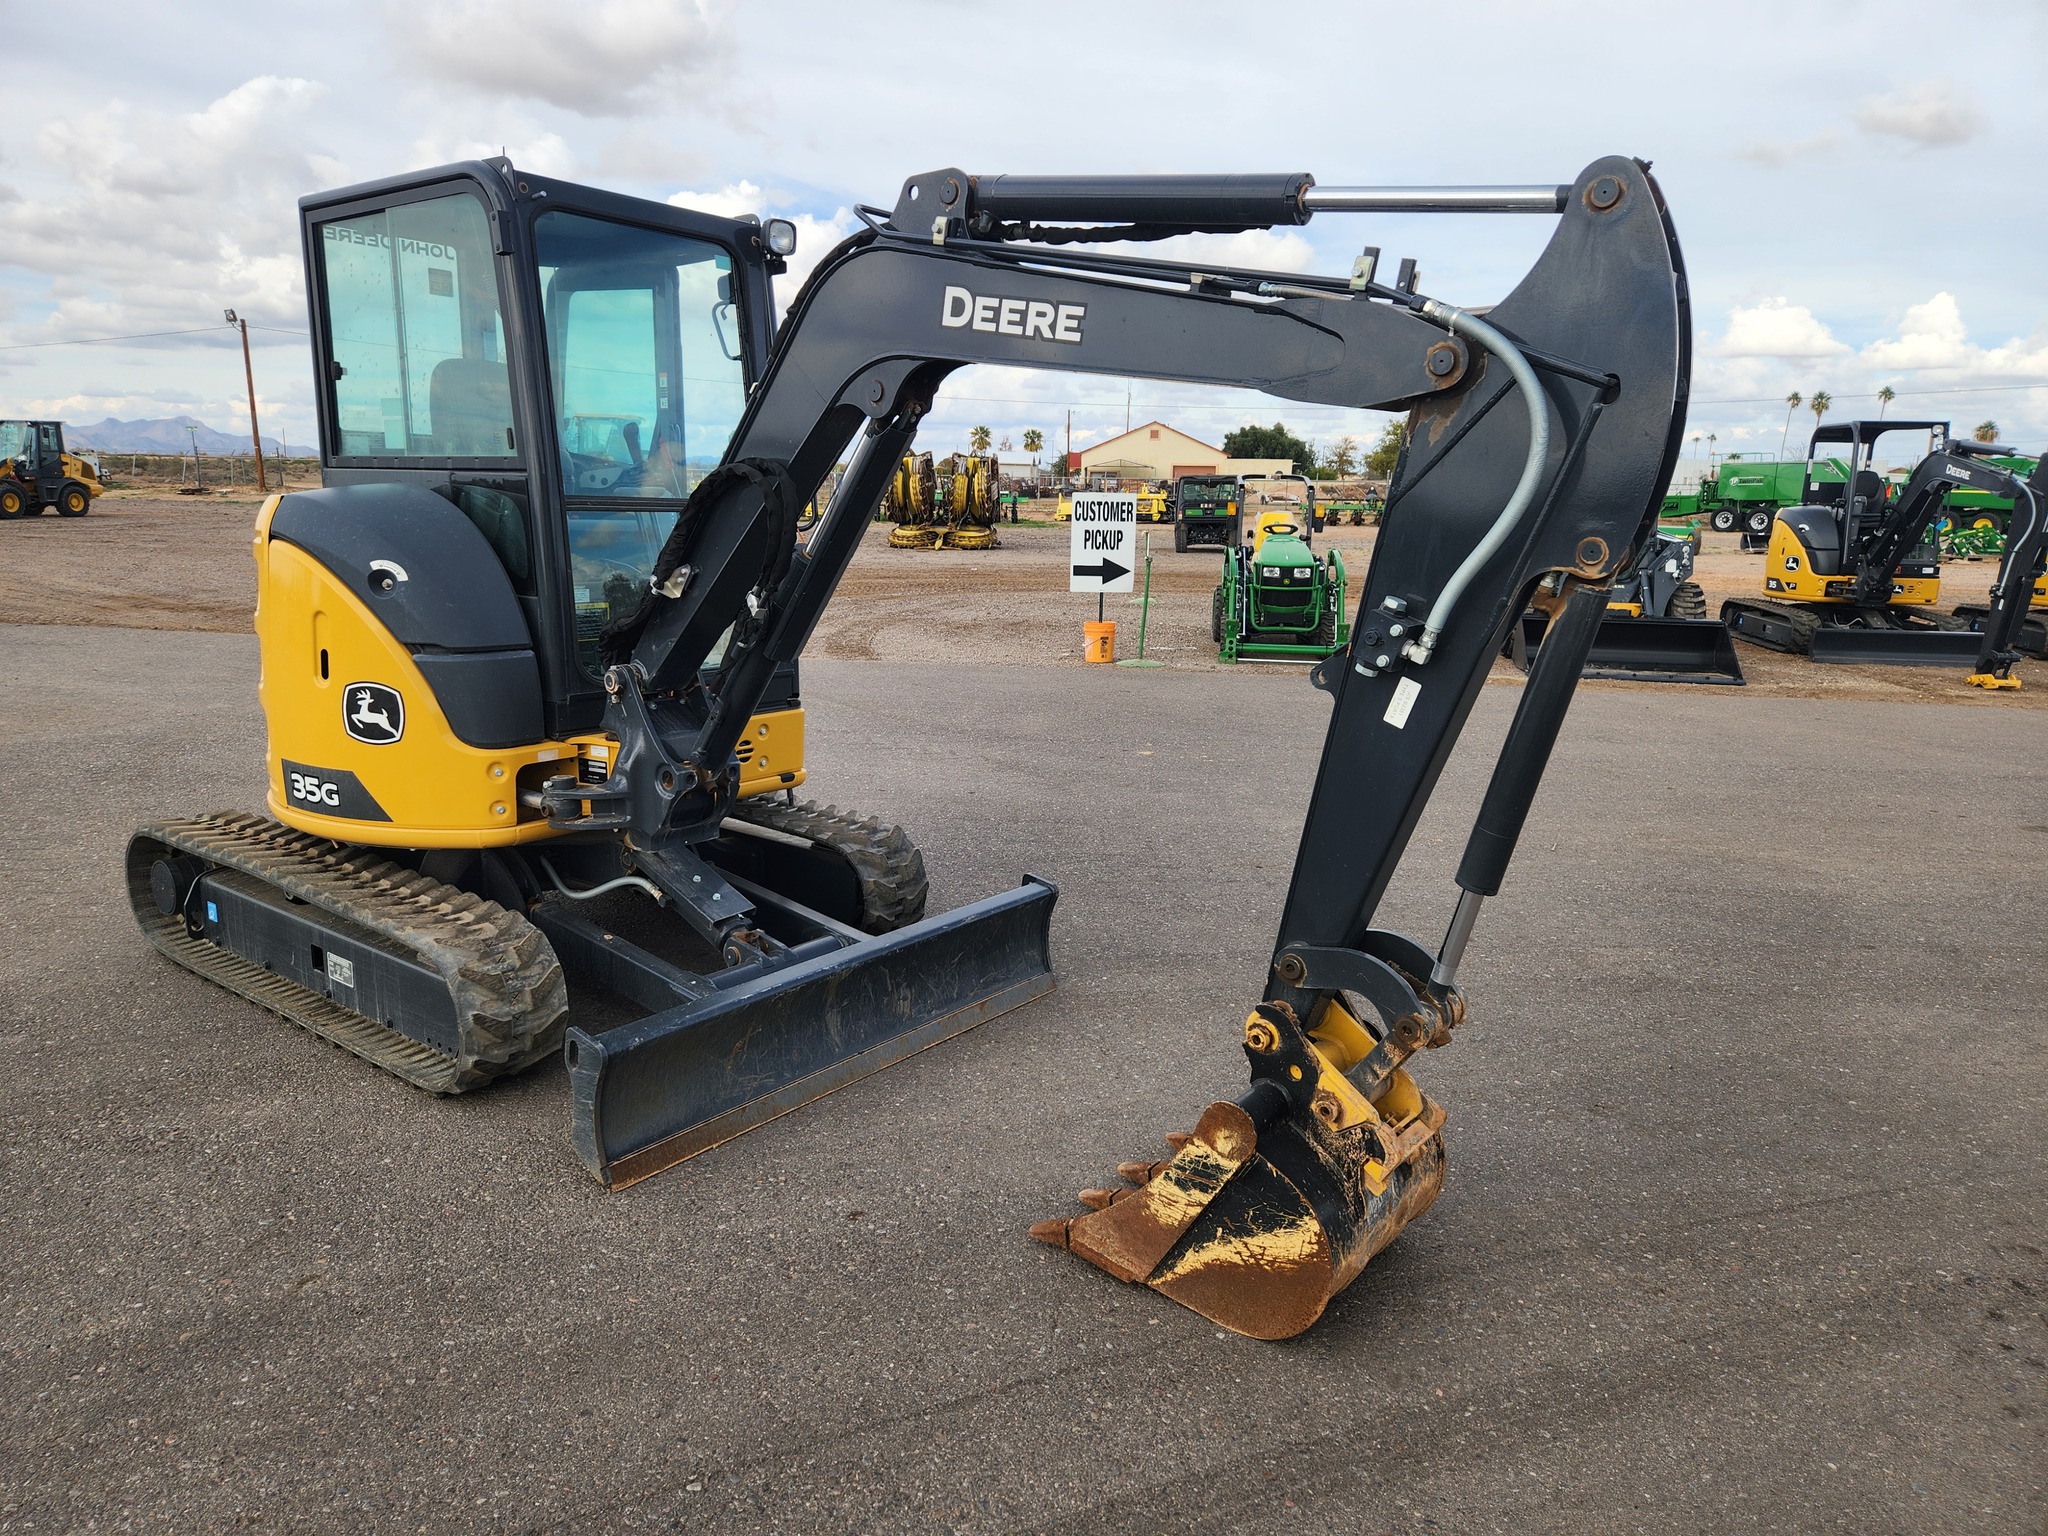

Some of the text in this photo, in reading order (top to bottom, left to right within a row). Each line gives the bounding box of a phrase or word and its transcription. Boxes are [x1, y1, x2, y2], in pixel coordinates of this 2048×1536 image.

[942, 286, 1085, 342] DEERE
[1945, 463, 1971, 480] DEERE
[1074, 500, 1134, 522] CUSTOMER
[1084, 529, 1124, 550] PICKUP
[1768, 580, 1777, 588] 35
[290, 772, 341, 806] 35G
